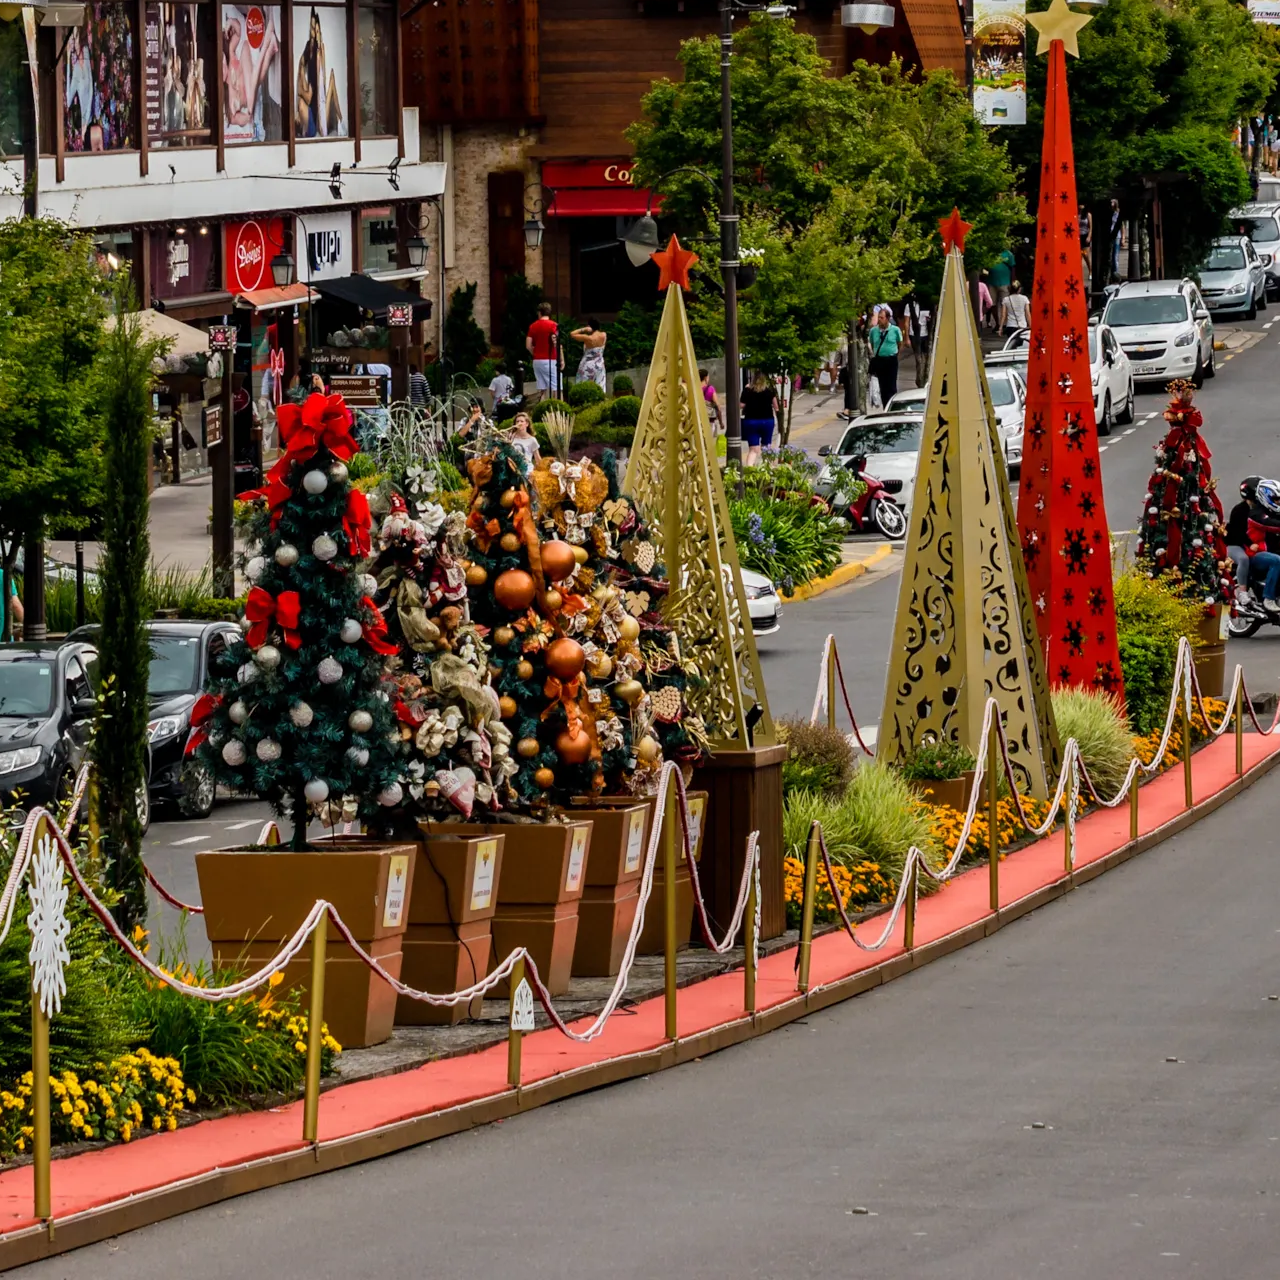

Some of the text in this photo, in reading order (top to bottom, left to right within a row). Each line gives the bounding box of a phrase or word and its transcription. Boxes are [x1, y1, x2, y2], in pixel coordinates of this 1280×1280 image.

[312, 229, 342, 266] LUPO
[311, 354, 350, 363] João Petry
